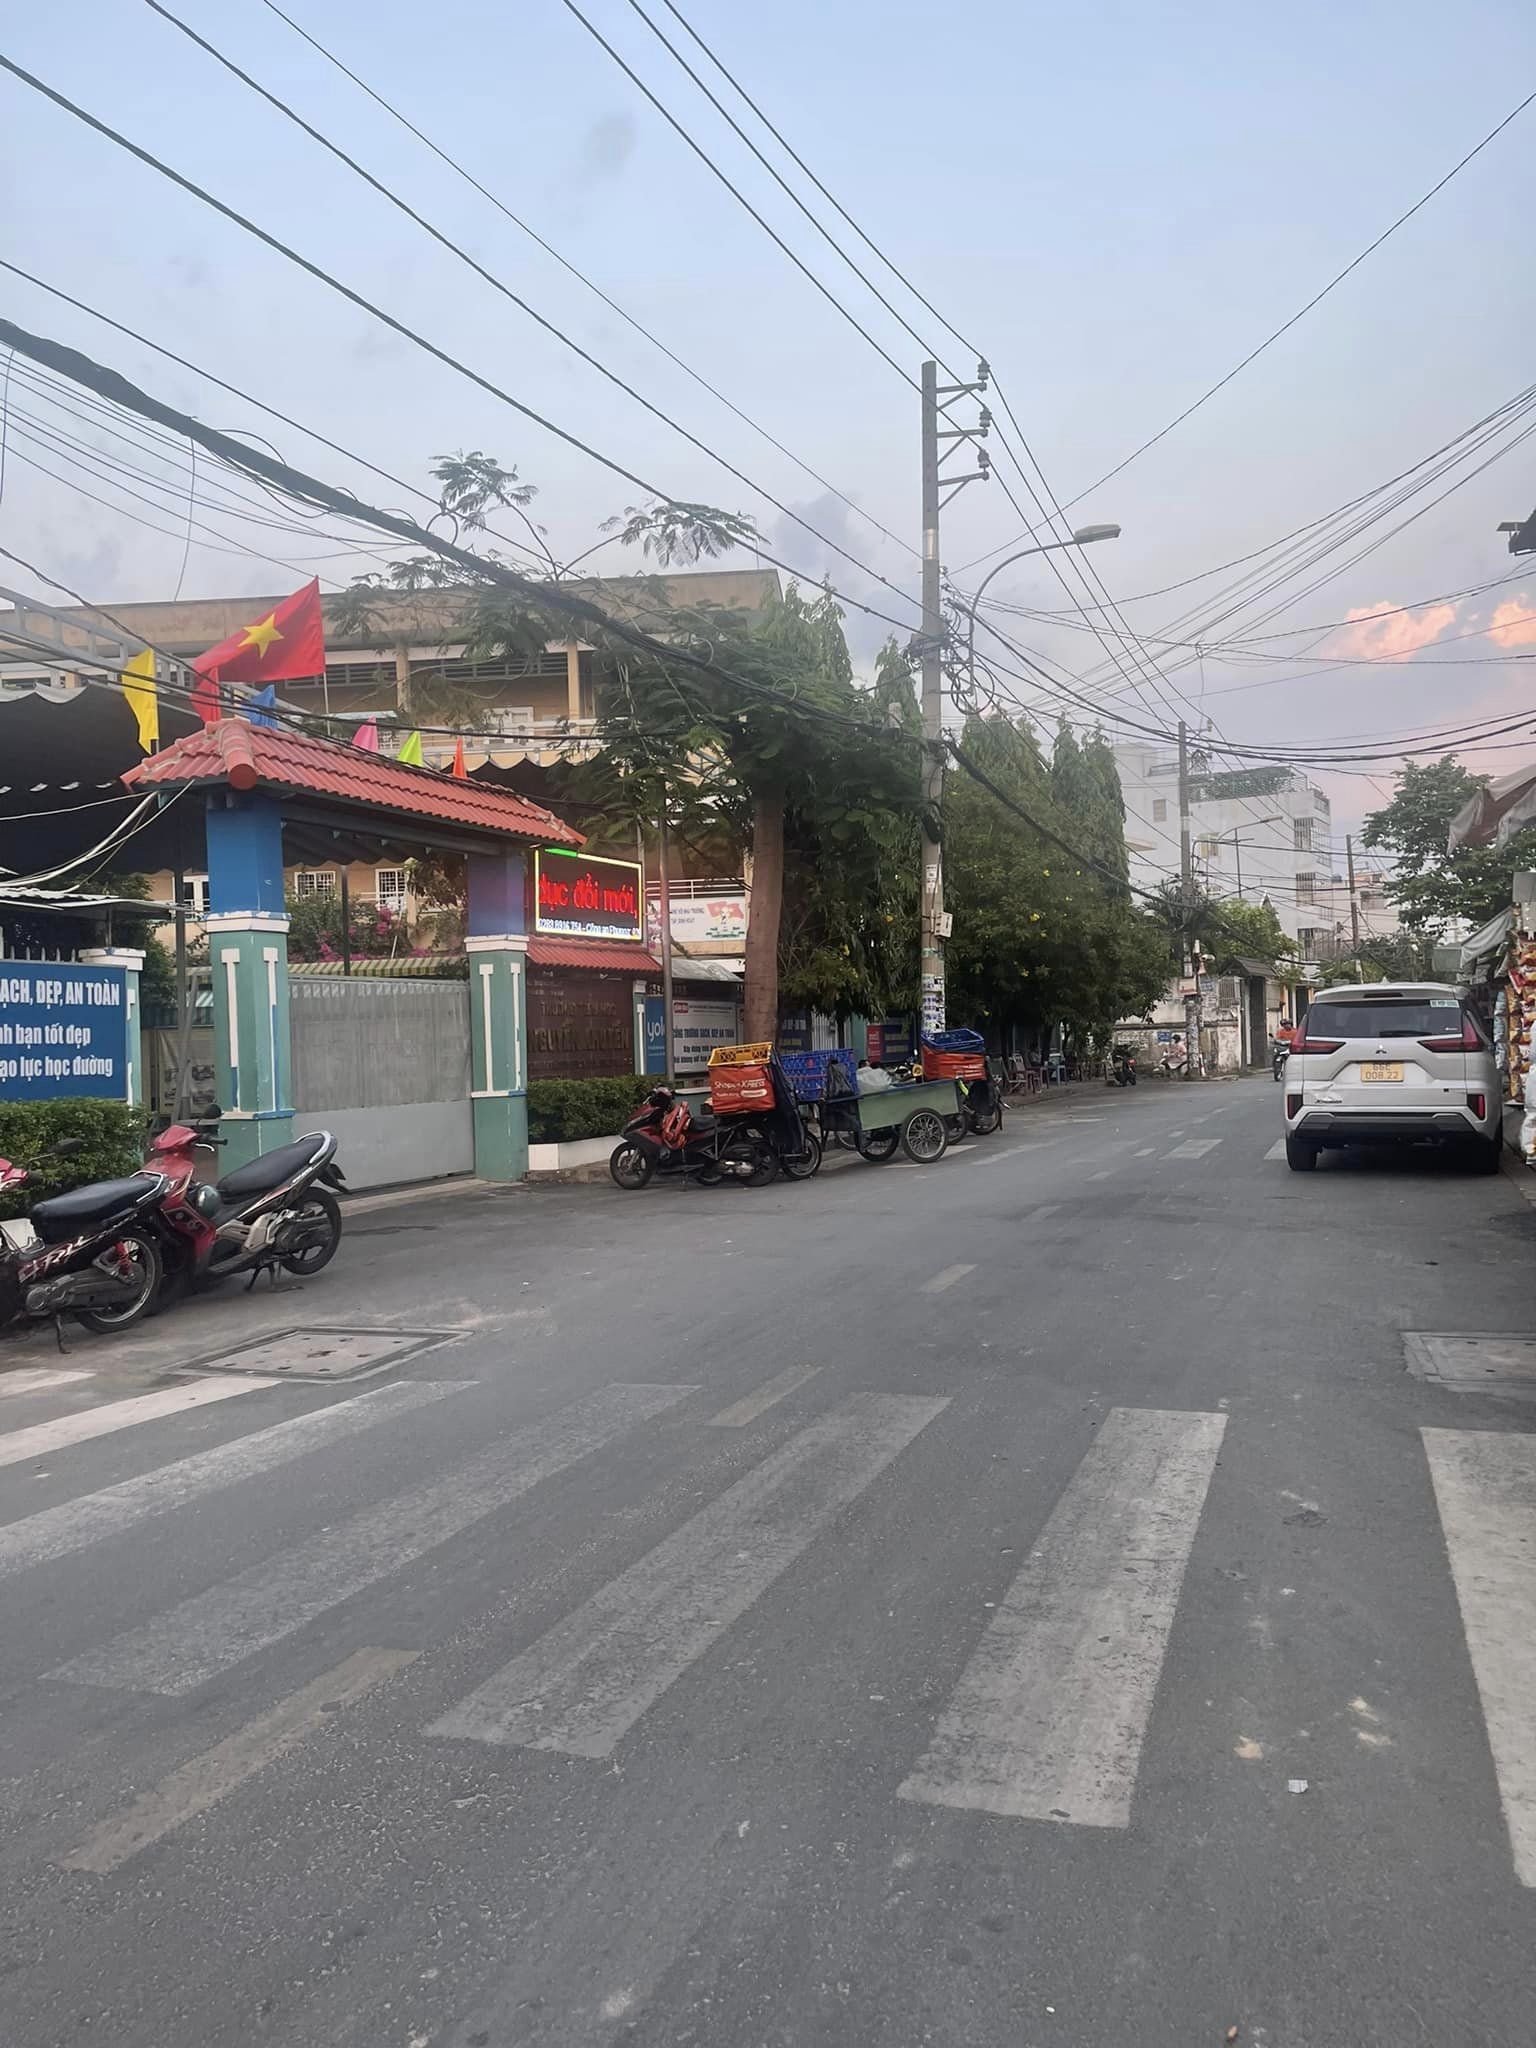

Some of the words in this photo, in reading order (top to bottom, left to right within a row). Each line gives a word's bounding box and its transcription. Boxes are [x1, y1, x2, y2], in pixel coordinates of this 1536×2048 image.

[573, 872, 598, 910] đổi
[36, 980, 63, 1009] ĐẸP,
[65, 981, 83, 1005] AN
[86, 978, 120, 1006] TOÀN
[15, 1024, 42, 1049] bạn
[45, 1022, 64, 1044] tốt
[66, 1024, 91, 1049] đẹp
[20, 1056, 42, 1081] lực
[45, 1056, 70, 1080] học
[73, 1055, 113, 1077] đường
